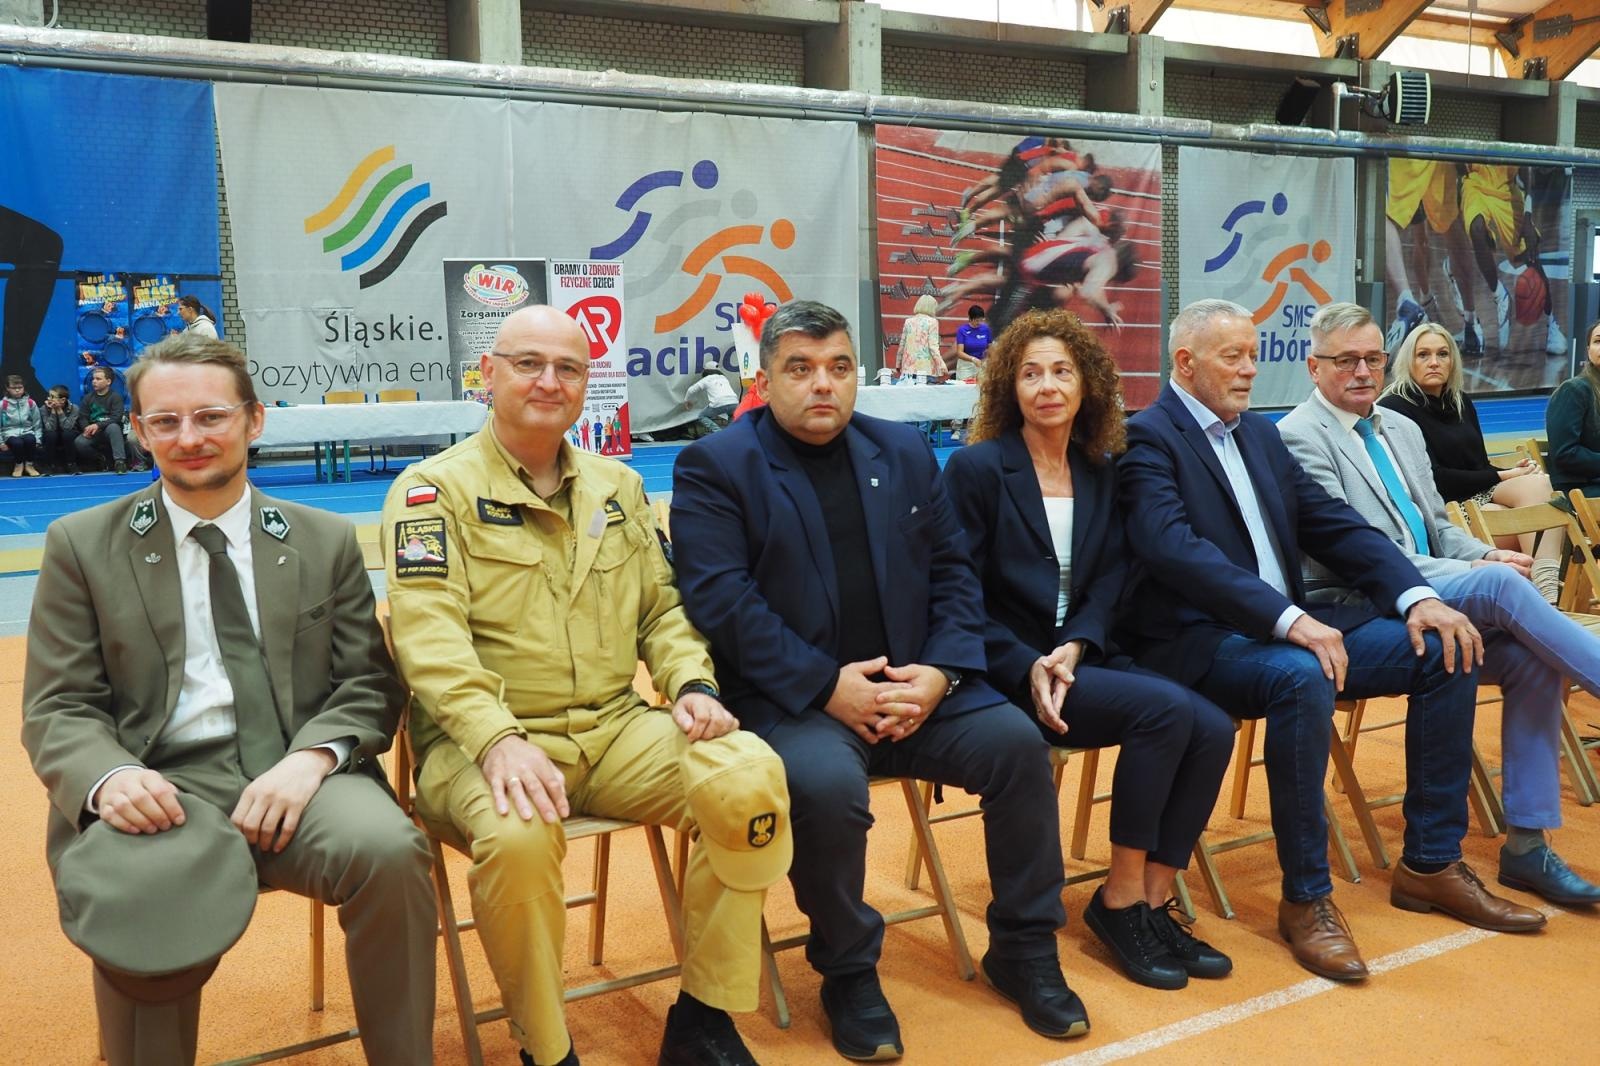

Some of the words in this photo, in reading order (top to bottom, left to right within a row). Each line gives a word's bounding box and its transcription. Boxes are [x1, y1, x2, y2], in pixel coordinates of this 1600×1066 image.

[554, 264, 580, 275] DBAMY
[582, 264, 587, 275] O
[589, 264, 621, 276] ZDROWIE
[478, 272, 515, 295] WIR
[560, 276, 592, 288] FIZYCZNE
[593, 277, 615, 288] DZIECI
[460, 309, 514, 320] Zorganizu
[1282, 304, 1317, 328] SMS
[325, 310, 443, 348] Śląskie.
[626, 336, 740, 377] acib
[1255, 329, 1312, 362] ibór
[410, 361, 451, 382] en
